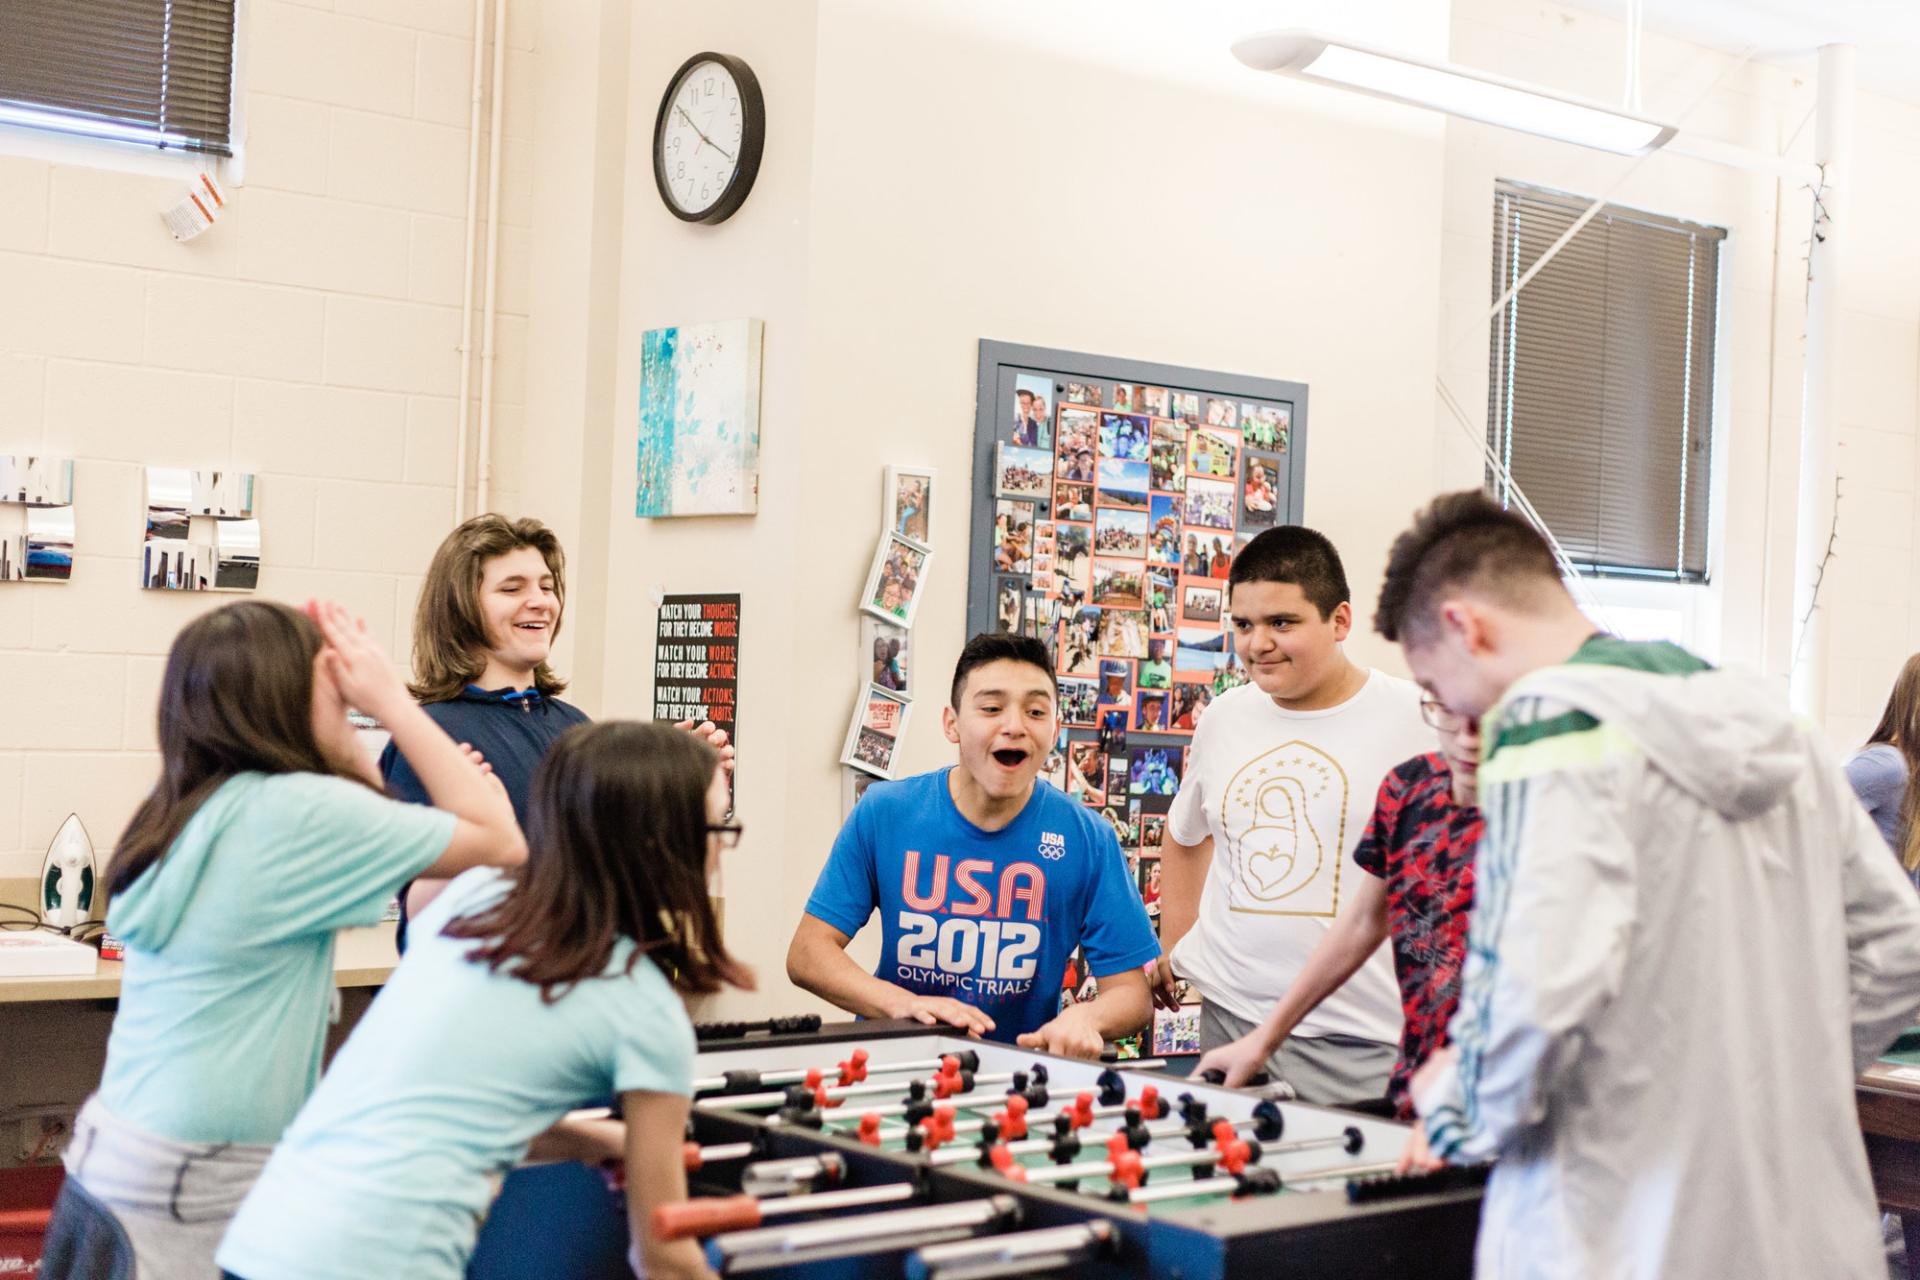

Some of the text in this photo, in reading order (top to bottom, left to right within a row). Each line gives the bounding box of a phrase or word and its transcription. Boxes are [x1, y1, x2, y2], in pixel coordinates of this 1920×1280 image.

[704, 78, 715, 96] 12
[690, 87, 699, 106] 11
[729, 97, 738, 116] 2
[672, 136, 681, 154] 9
[676, 161, 686, 179] 8
[687, 178, 696, 197] 7
[716, 171, 725, 190] 5
[700, 182, 709, 200] 6
[661, 605, 682, 619] WATCH
[684, 604, 701, 619] YOUR
[660, 622, 672, 637] FOR
[674, 622, 689, 637] THEY
[690, 622, 713, 637] BECOME
[658, 645, 683, 661] WATCH
[686, 645, 707, 661] YOUR
[657, 663, 670, 678] FOR
[671, 663, 685, 678] THEY
[685, 663, 709, 679] BECOME
[657, 686, 681, 702] WATCH
[682, 687, 701, 702] YOUR
[656, 705, 668, 719] FOR
[670, 705, 684, 720] THEY
[685, 705, 709, 721] BECOME
[1041, 832, 1065, 847] USA
[897, 910, 1041, 980] 2012
[897, 966, 973, 991] OLYMPIC
[976, 978, 1032, 995] TRIALS
